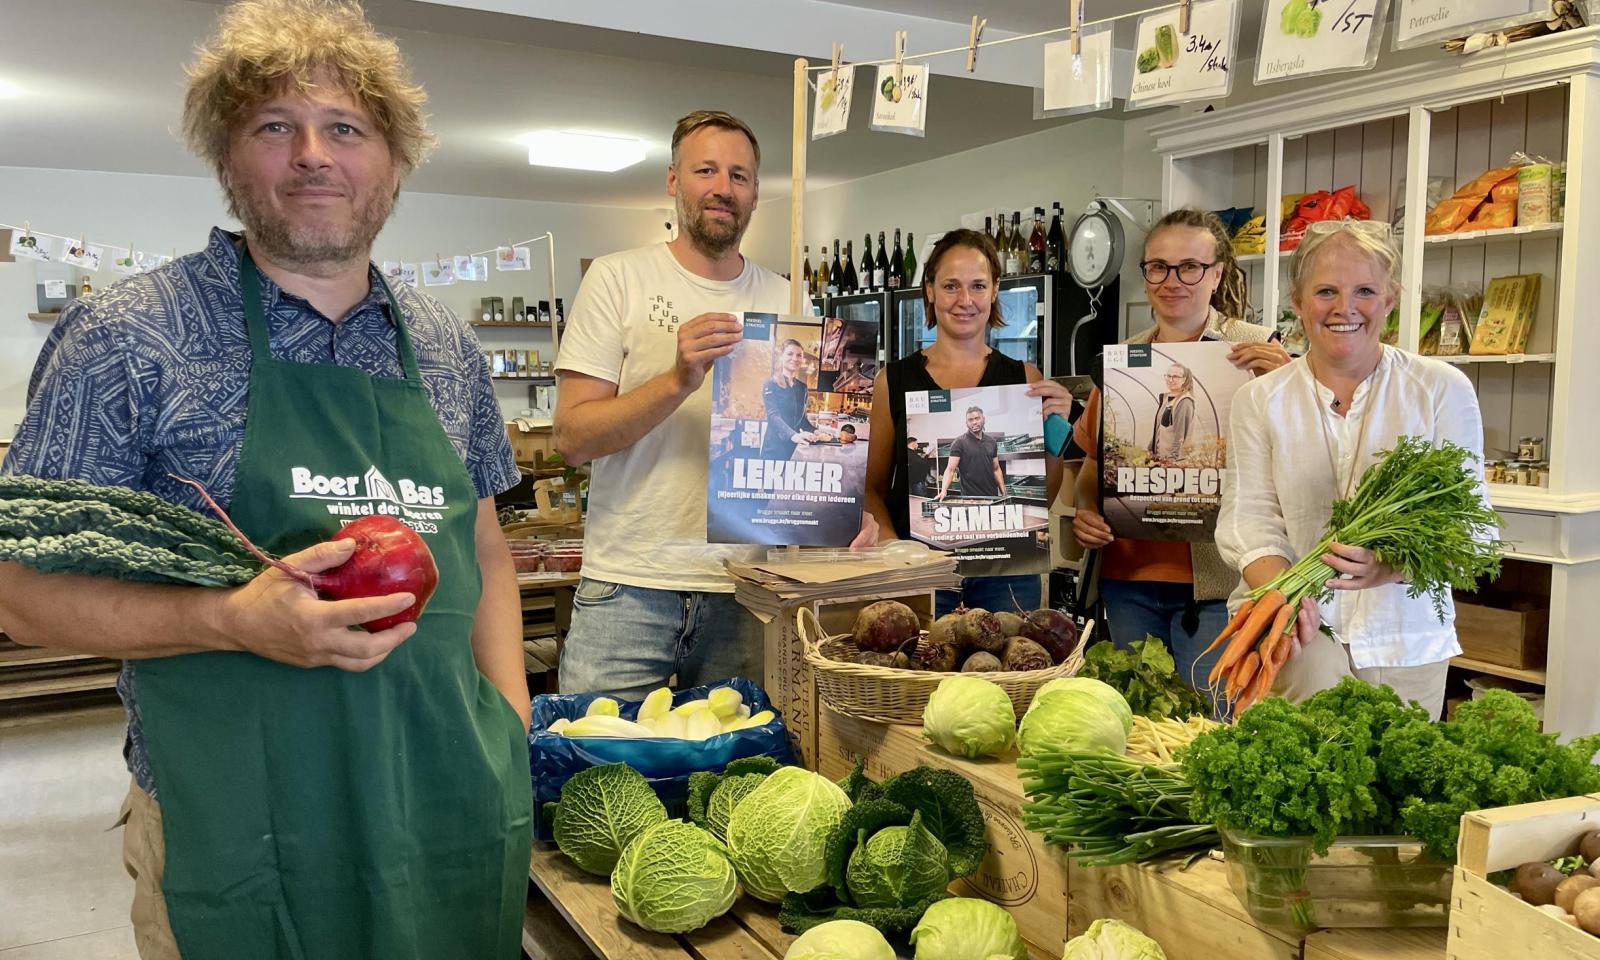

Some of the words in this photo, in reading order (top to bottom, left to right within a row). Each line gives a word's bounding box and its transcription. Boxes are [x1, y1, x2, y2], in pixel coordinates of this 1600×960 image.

[1409, 8, 1450, 29] Peterselie
[1132, 80, 1156, 94] Chinese
[291, 466, 360, 496] Boer
[398, 478, 445, 506] Bas
[732, 457, 843, 494] LEKKER
[326, 501, 374, 516] winkel
[377, 501, 400, 516] der
[752, 492, 776, 500] smaken
[792, 493, 805, 501] elke
[806, 495, 818, 503] dag
[828, 496, 856, 504] iedereen
[934, 503, 1024, 533] SAMEN
[802, 660, 810, 732] HATEAU
